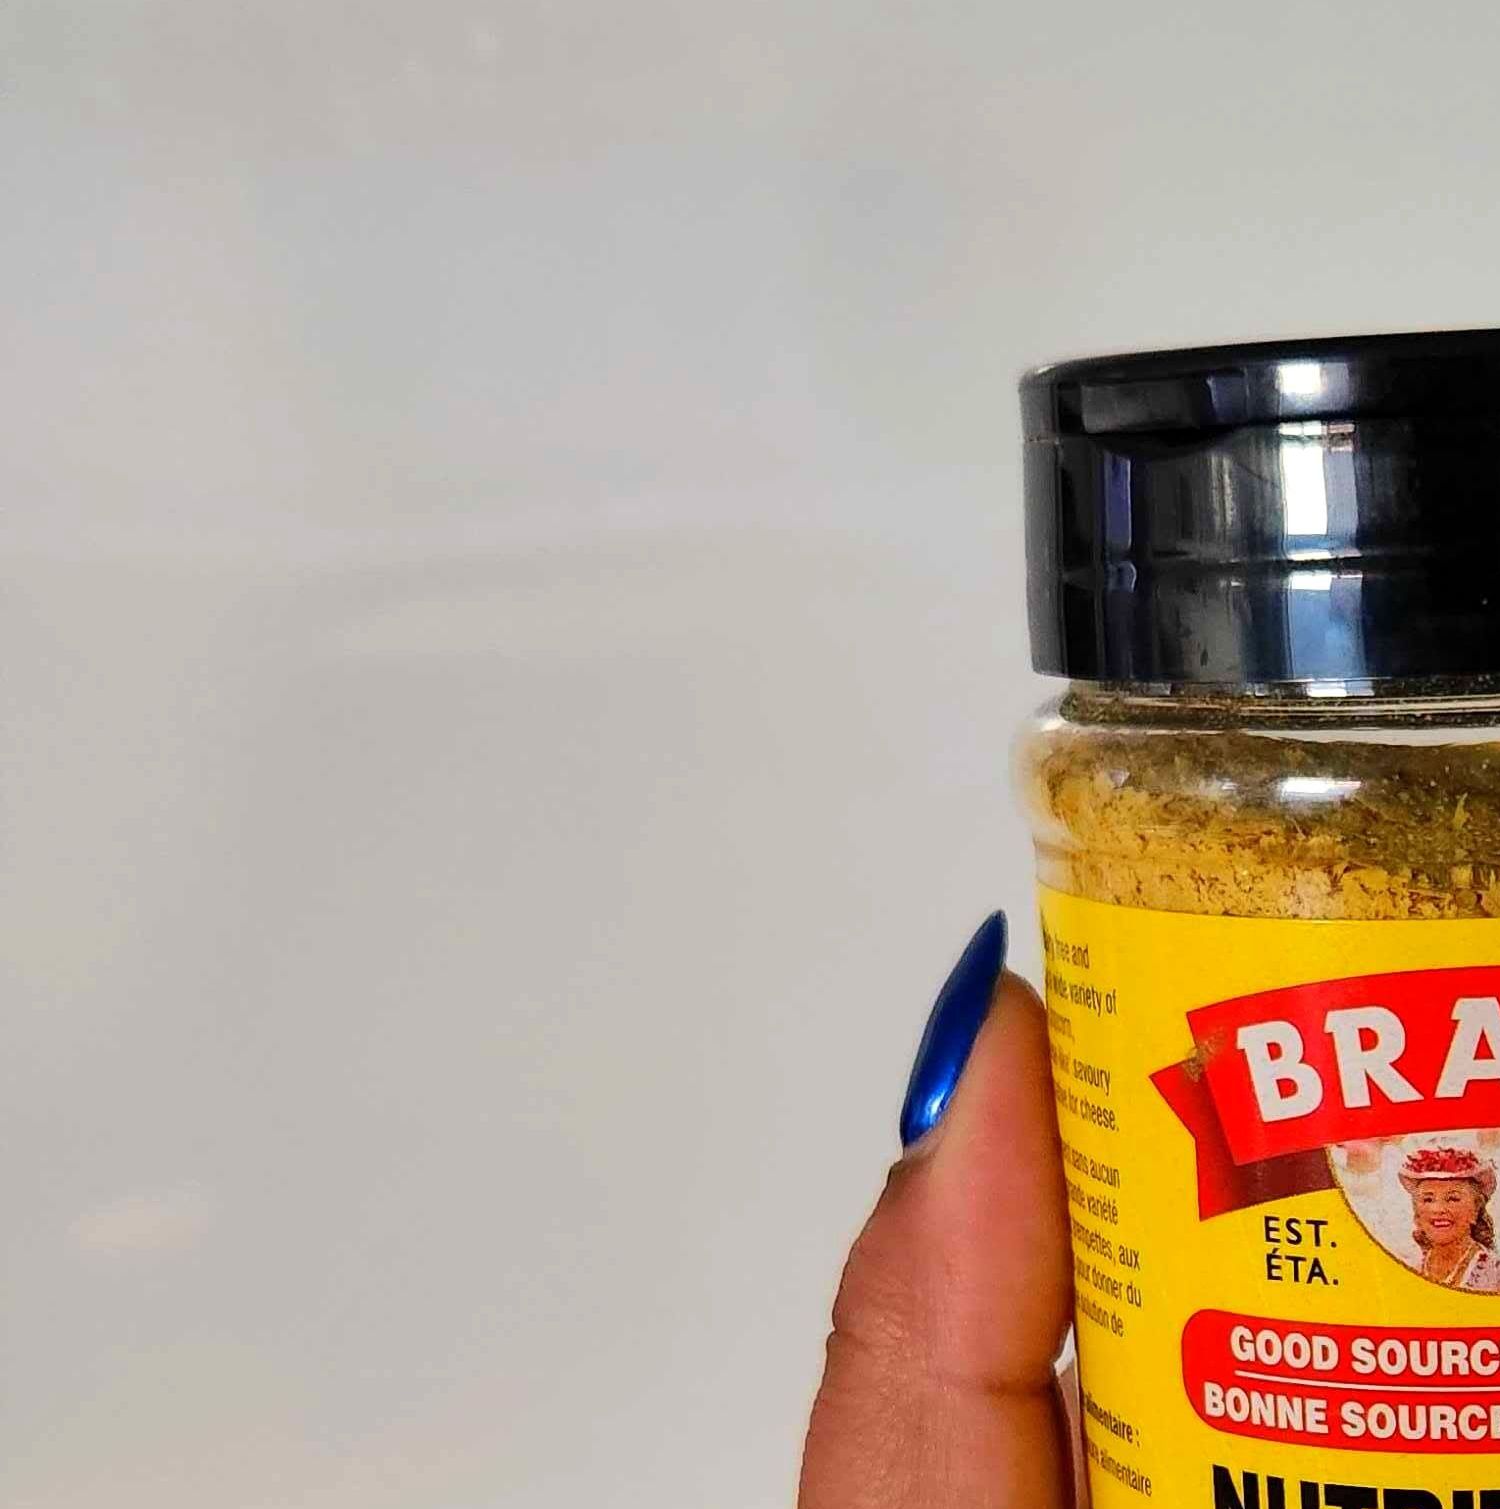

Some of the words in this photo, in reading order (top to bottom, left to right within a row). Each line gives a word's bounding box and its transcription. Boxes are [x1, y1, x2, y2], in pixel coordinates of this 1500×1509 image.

[1072, 944, 1090, 969] and
[1070, 982, 1102, 1017] variety
[1105, 987, 1117, 1015] of
[1073, 1057, 1111, 1096] savoury
[1080, 1097, 1120, 1132] cheese.
[1089, 1158, 1121, 1189] aucun
[1264, 1214, 1338, 1249] EST.
[1118, 1243, 1142, 1272] aux
[1265, 1248, 1340, 1287] ÉTA.
[1092, 1265, 1123, 1300] donner
[1126, 1281, 1142, 1308] du
[1110, 1312, 1125, 1338] de
[1229, 1325, 1340, 1372] GOOD
[1203, 1381, 1329, 1435] BONNE
